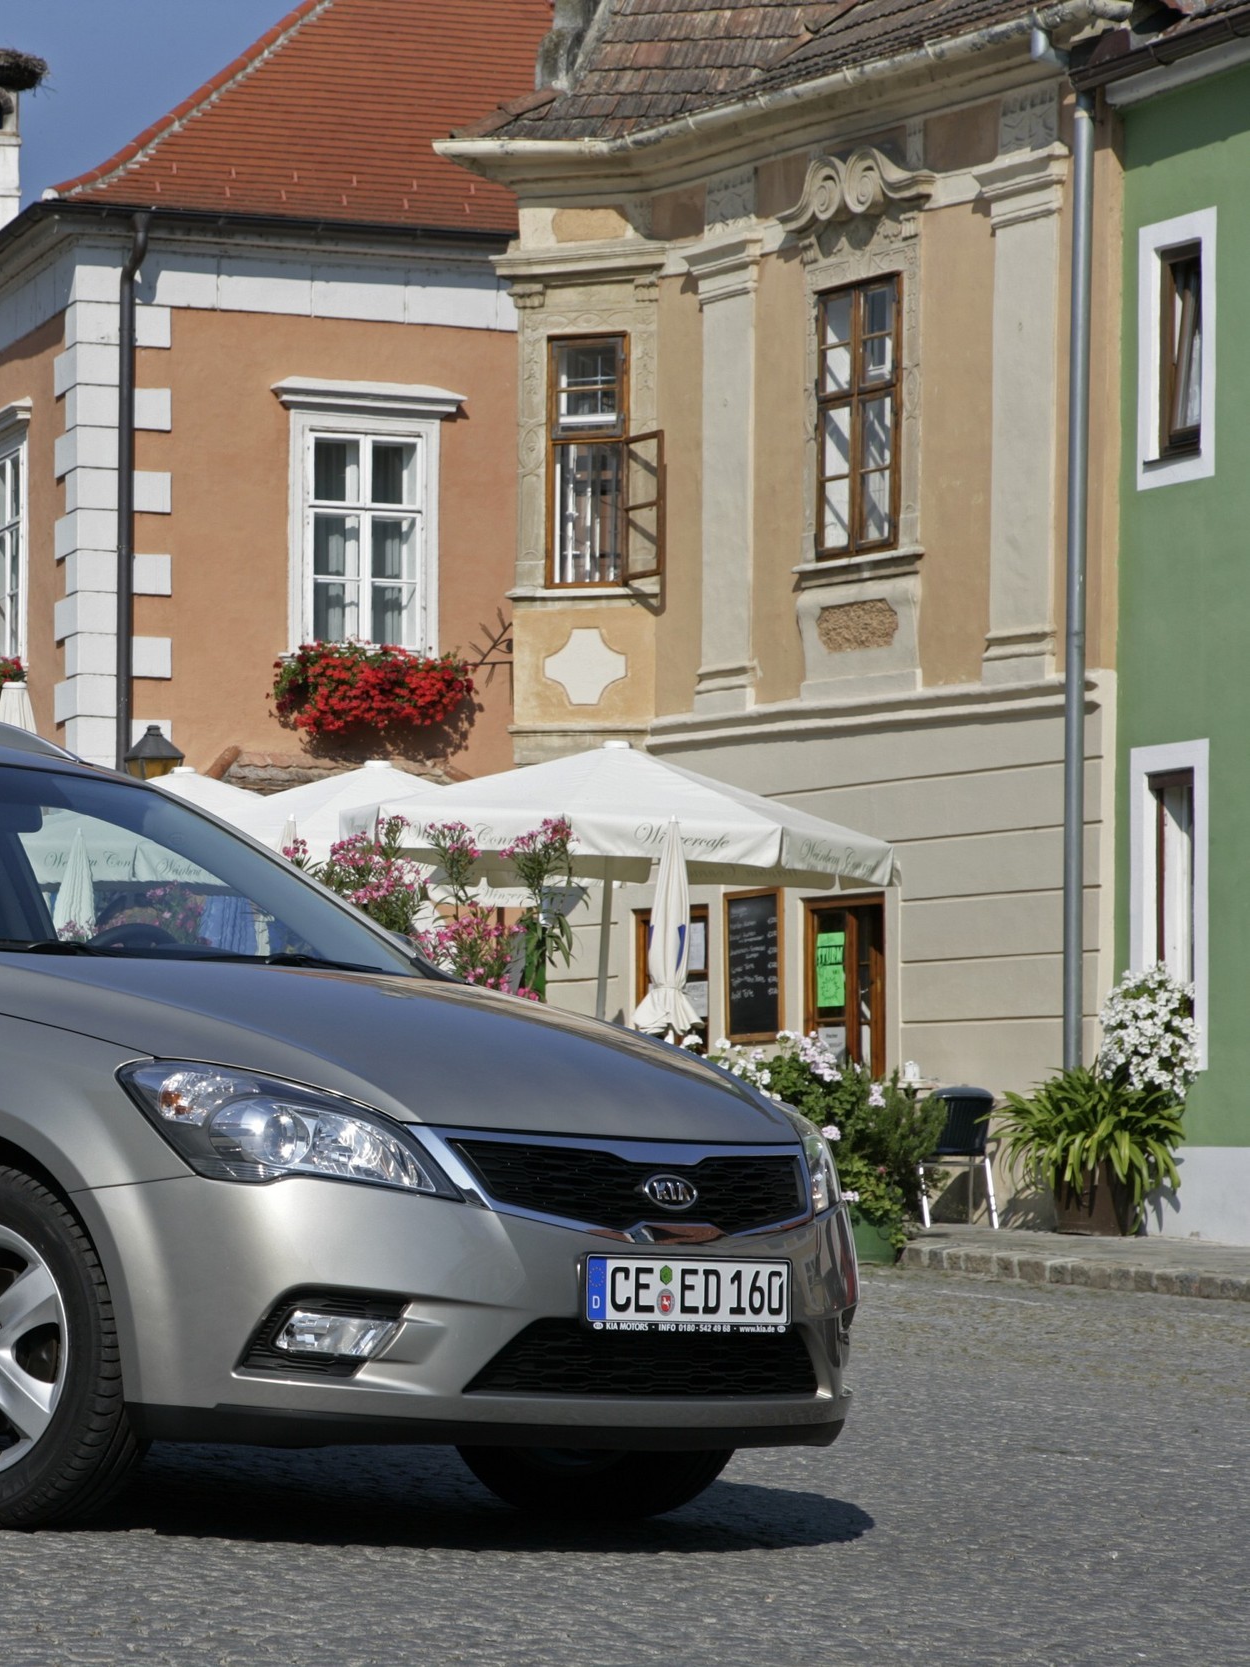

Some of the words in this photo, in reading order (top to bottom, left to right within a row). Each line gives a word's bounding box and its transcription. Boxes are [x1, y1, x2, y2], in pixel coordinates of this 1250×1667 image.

[634, 822, 730, 853] Wiercafe
[653, 1182, 691, 1201] KIA
[611, 1266, 655, 1313] CE
[681, 1268, 721, 1315] ED
[729, 1270, 784, 1315] 160
[592, 1295, 601, 1309] D
[606, 1322, 618, 1330] KIA
[620, 1322, 649, 1331] MOTORS
[659, 1323, 676, 1332] INFO
[739, 1325, 775, 1333] www.kia.de
